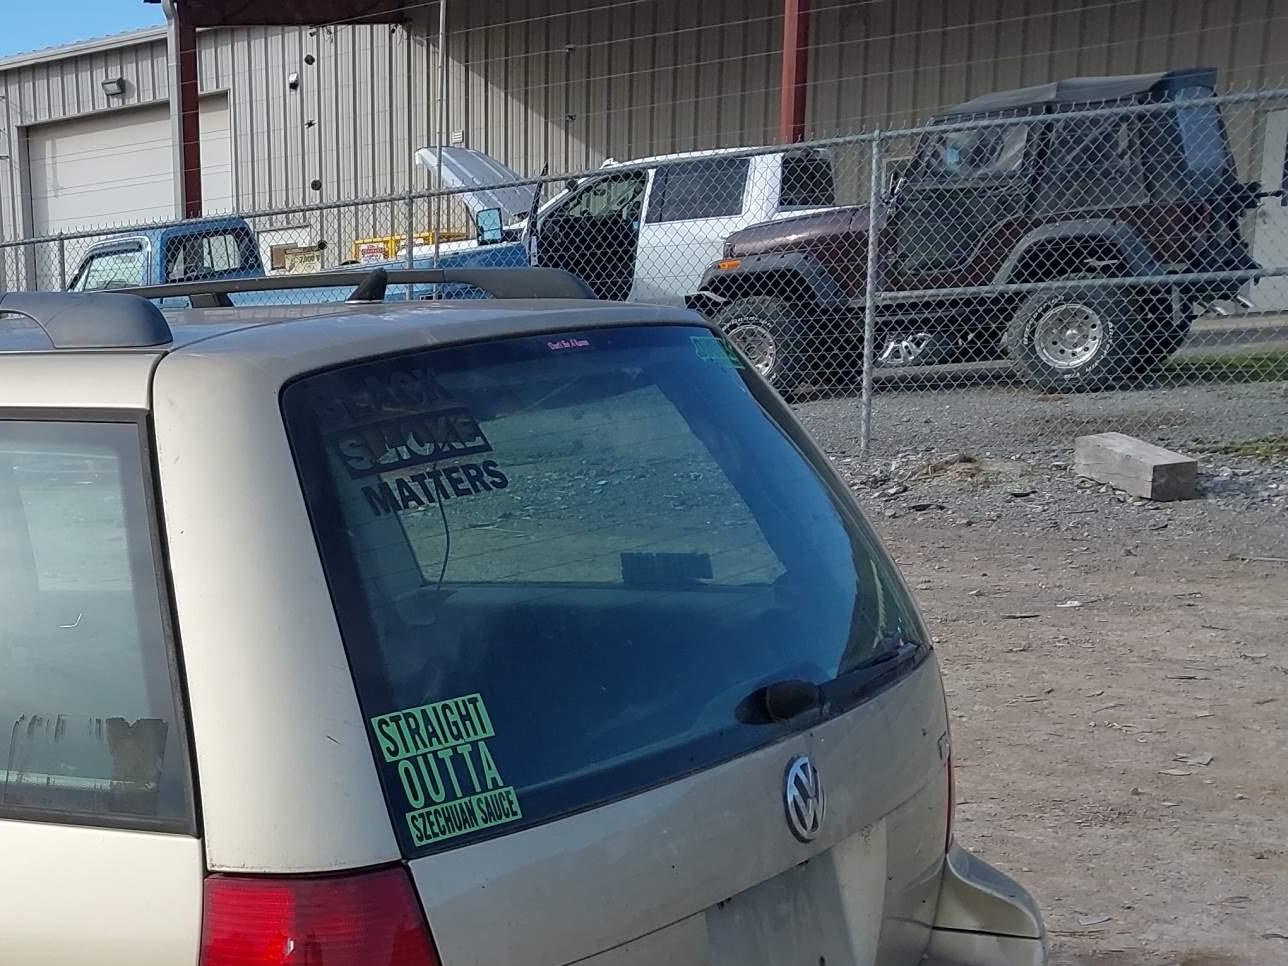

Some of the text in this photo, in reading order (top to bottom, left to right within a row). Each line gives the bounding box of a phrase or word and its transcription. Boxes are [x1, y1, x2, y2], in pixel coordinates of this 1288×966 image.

[362, 460, 509, 516] MATTERS
[377, 696, 487, 758] STRAIGHT
[397, 740, 505, 809] OUTTA
[410, 790, 519, 843] SZECHUAN SAUCE
